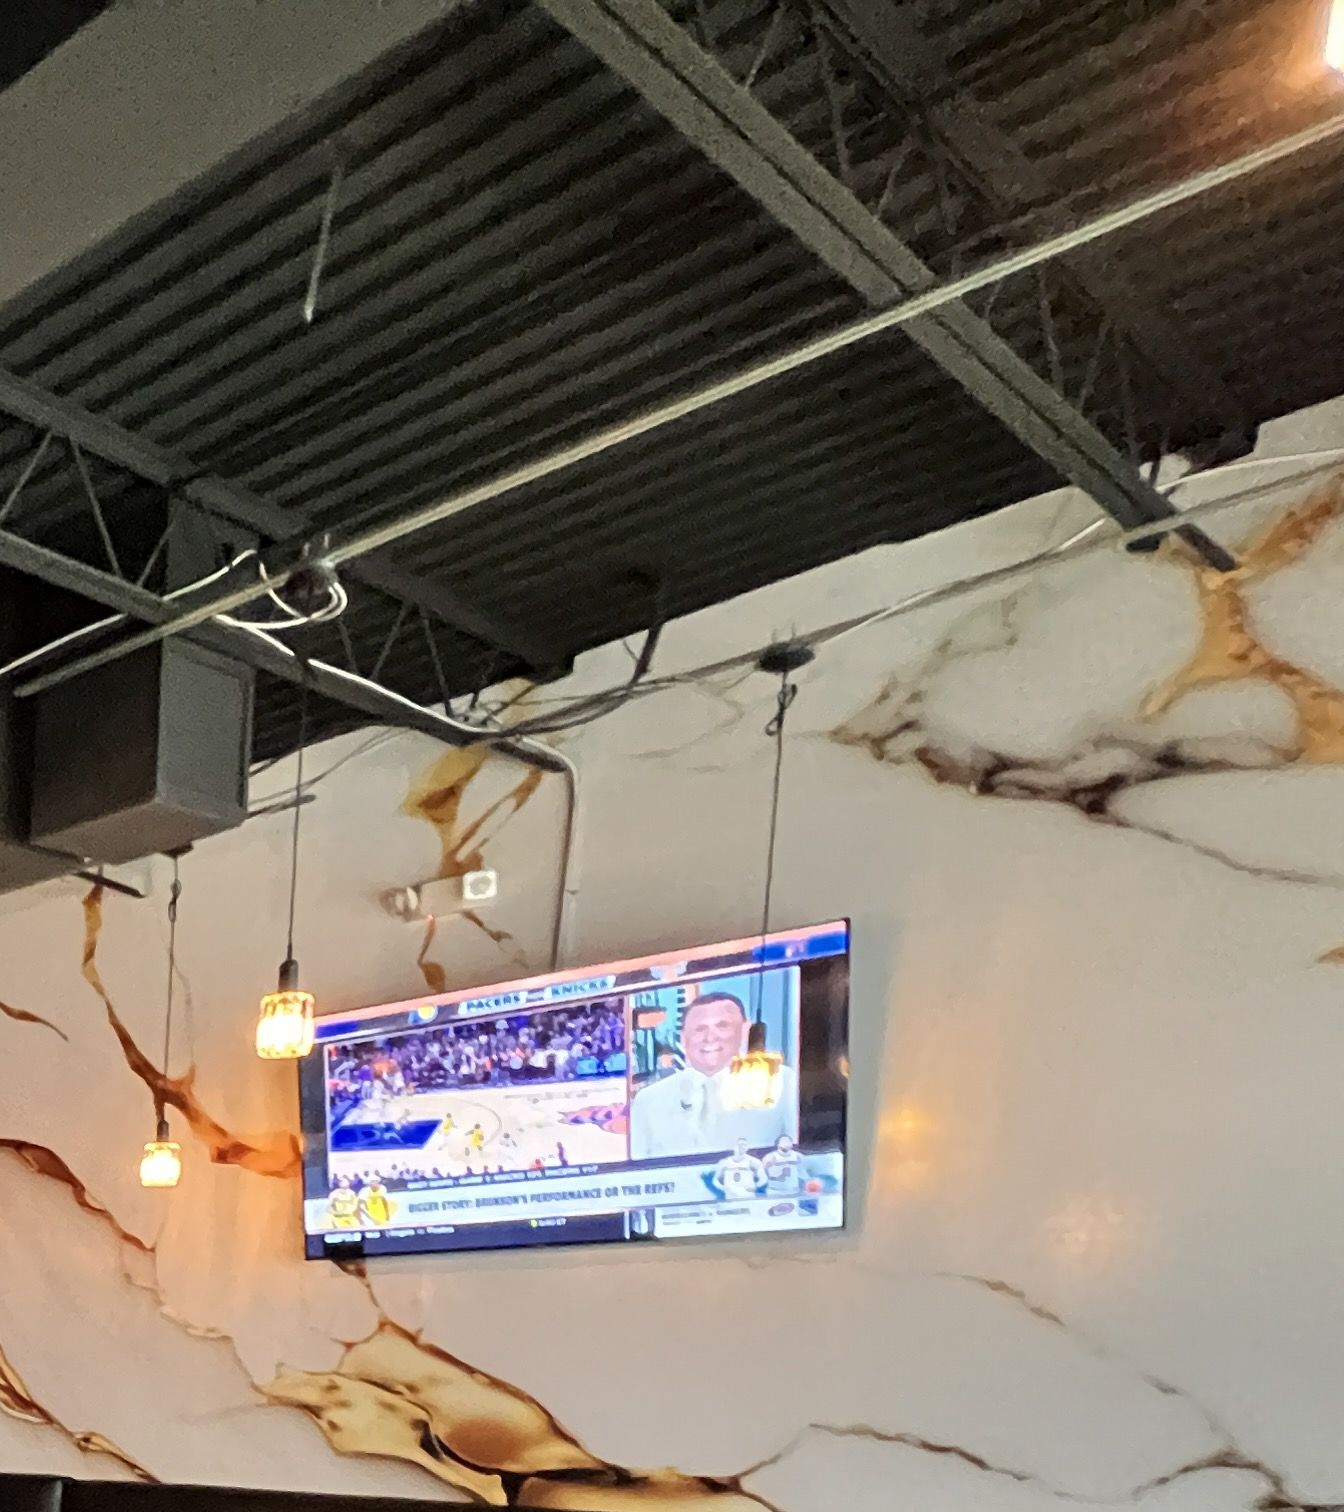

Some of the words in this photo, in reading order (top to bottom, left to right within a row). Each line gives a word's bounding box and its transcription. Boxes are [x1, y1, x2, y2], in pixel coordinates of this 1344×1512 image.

[466, 995, 520, 1010] PACERS
[529, 1188, 602, 1203] PERFORMANCE
[604, 1186, 619, 1198] OR
[621, 1184, 642, 1196] THE
